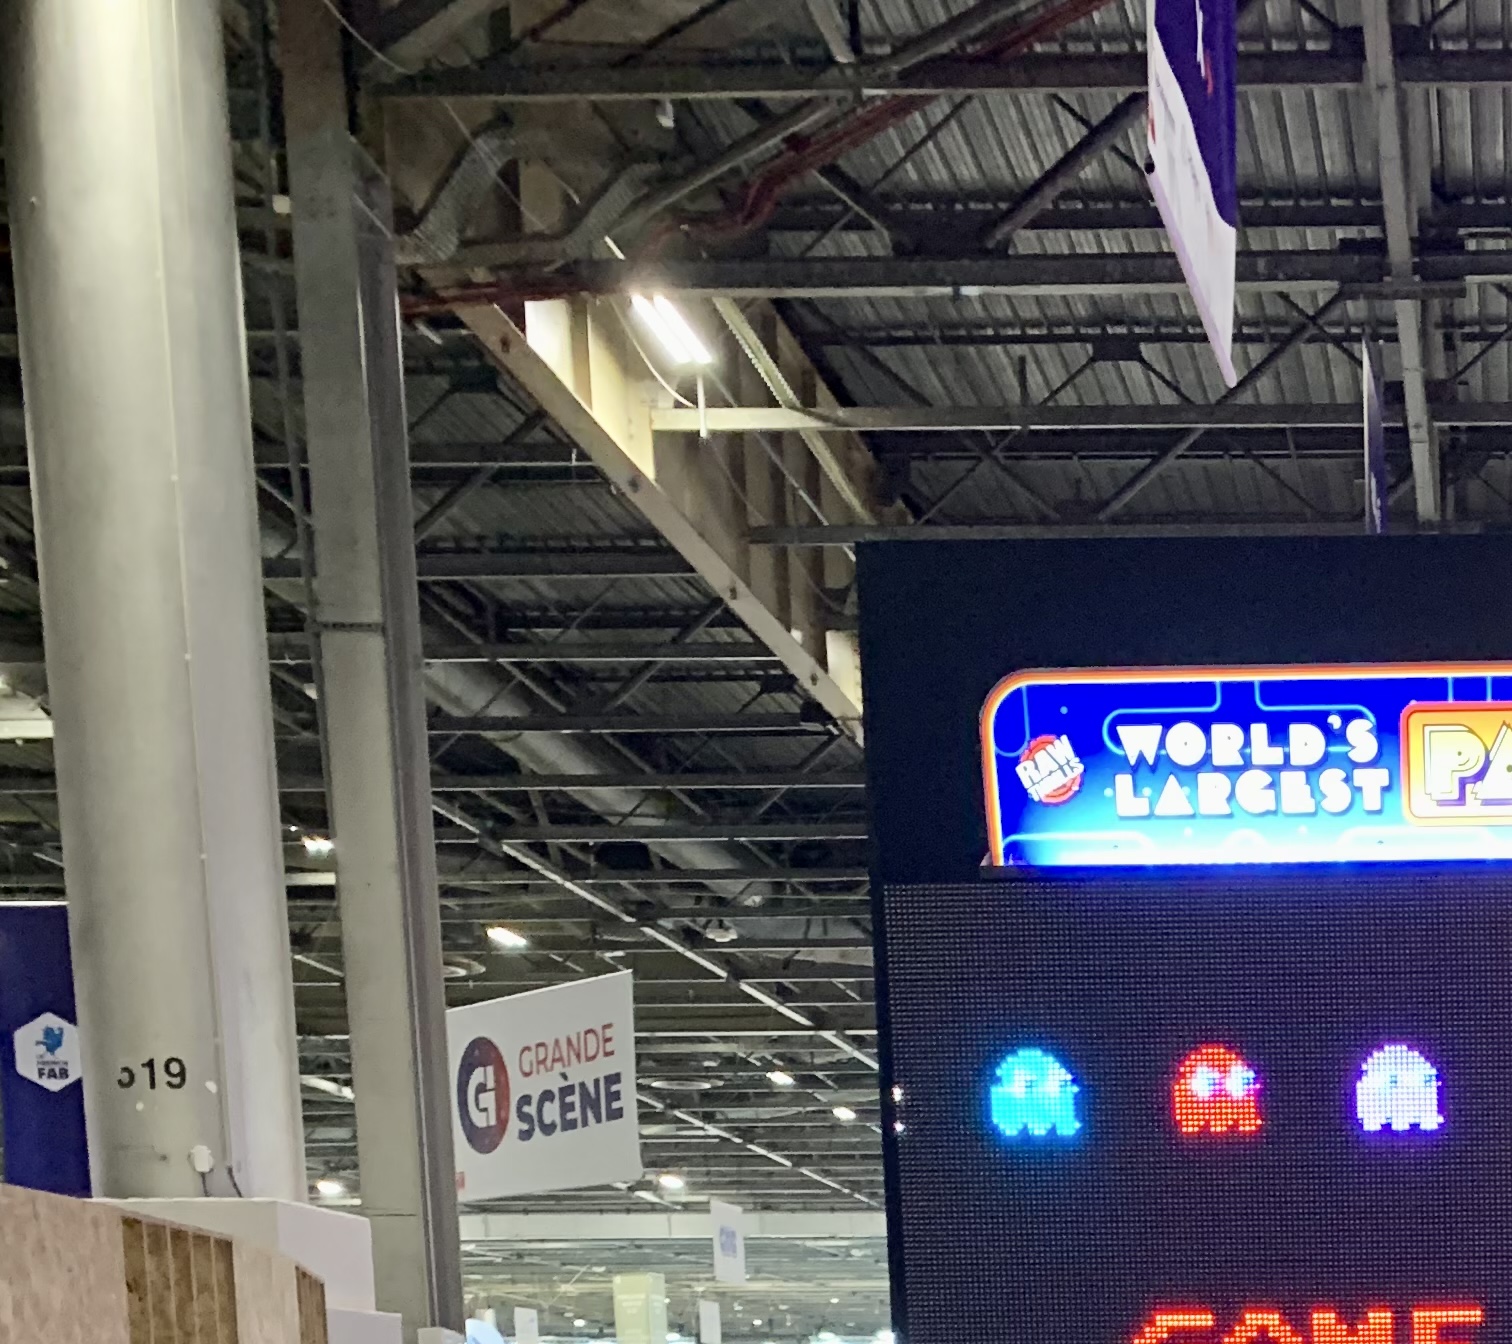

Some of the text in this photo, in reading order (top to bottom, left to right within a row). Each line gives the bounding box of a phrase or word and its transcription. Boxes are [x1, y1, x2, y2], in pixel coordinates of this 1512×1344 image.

[1015, 734, 1075, 789] RAW
[1115, 713, 1379, 767] WORLD'S
[1114, 767, 1391, 819] LARGEST
[518, 1022, 616, 1079] GRANDE
[516, 1071, 625, 1142] SCÈNE
